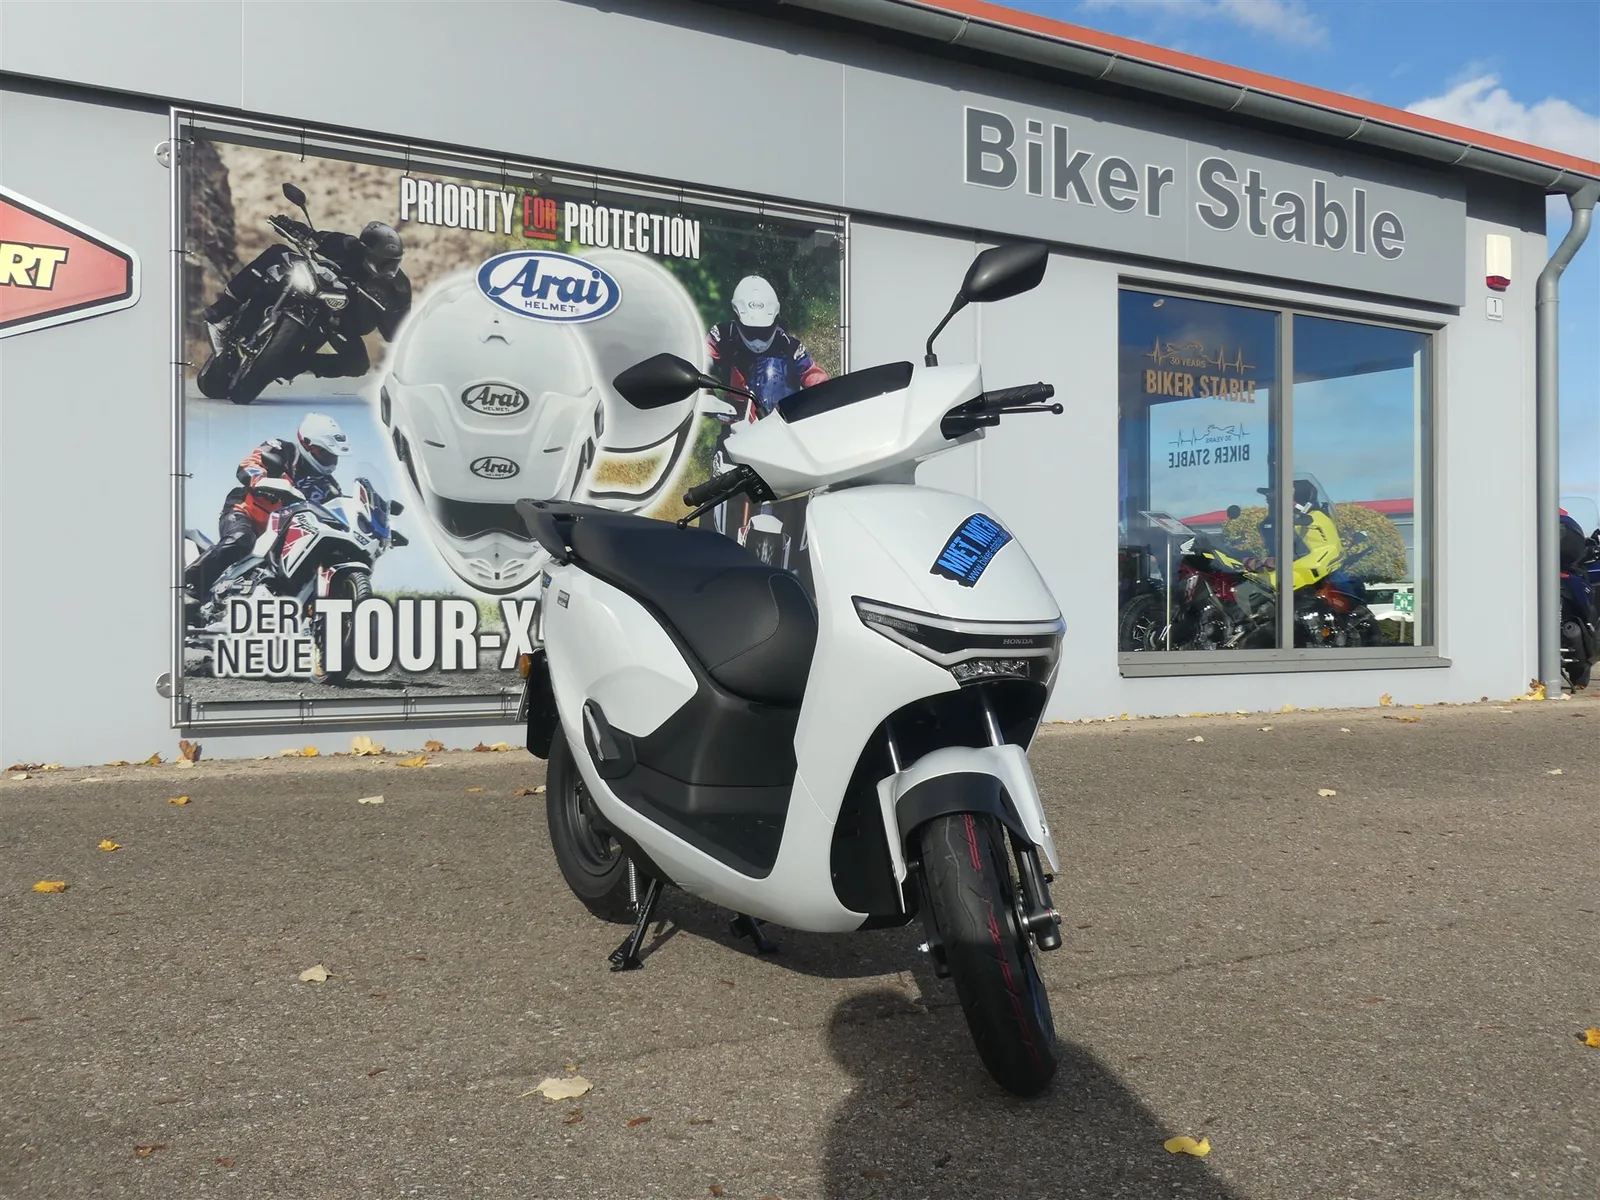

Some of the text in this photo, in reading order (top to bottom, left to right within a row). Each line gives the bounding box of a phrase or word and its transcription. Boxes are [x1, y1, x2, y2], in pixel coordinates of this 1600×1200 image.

[963, 105, 1406, 261] Biker Stable
[401, 177, 700, 259] PRIORITY FOR PROTECTION
[488, 259, 603, 305] Arai
[525, 301, 575, 312] HELMET
[1493, 299, 1497, 313] 1
[1170, 356, 1206, 368] 30 YEARS
[466, 386, 522, 408] Arai
[1145, 369, 1256, 403] BIKER STABLE
[474, 459, 514, 474] Arai
[938, 513, 1000, 577] MIET MICH
[230, 599, 299, 634] DER
[316, 598, 544, 672] TOUR-X
[218, 639, 313, 674] NEUE
